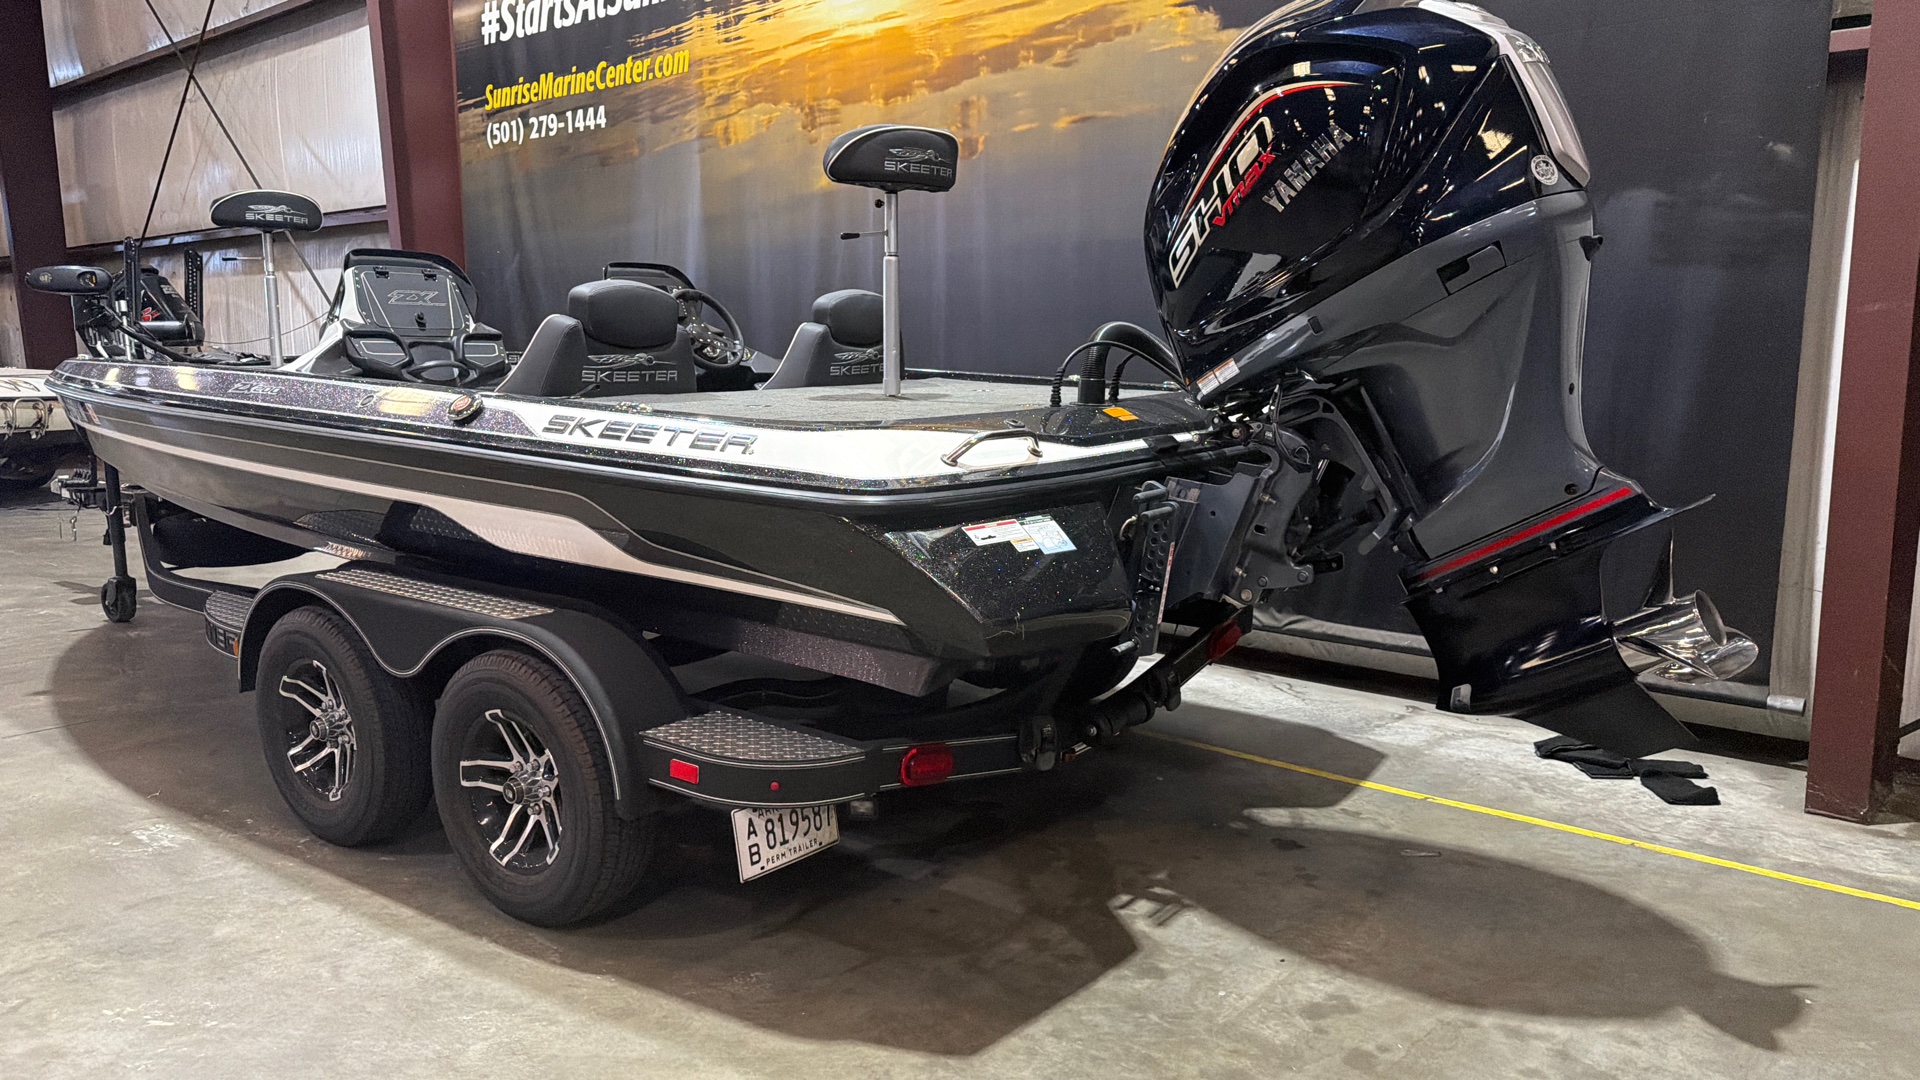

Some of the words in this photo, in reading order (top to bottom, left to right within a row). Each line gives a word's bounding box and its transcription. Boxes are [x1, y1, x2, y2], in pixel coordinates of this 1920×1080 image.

[481, 0, 668, 45] #StartsAt
[484, 49, 690, 111] SunriseMarineCenter.com
[486, 112, 524, 149] (501)
[529, 105, 607, 140] 279-1444
[884, 161, 953, 178] SKEETER
[1262, 124, 1354, 213] YAMAHA
[245, 212, 309, 225] SKEETER
[581, 369, 678, 383] SKEETER
[830, 363, 884, 377] SKEETE
[542, 414, 758, 455] SKEETER
[766, 850, 787, 866] PERM
[788, 838, 818, 857] TRAILER
